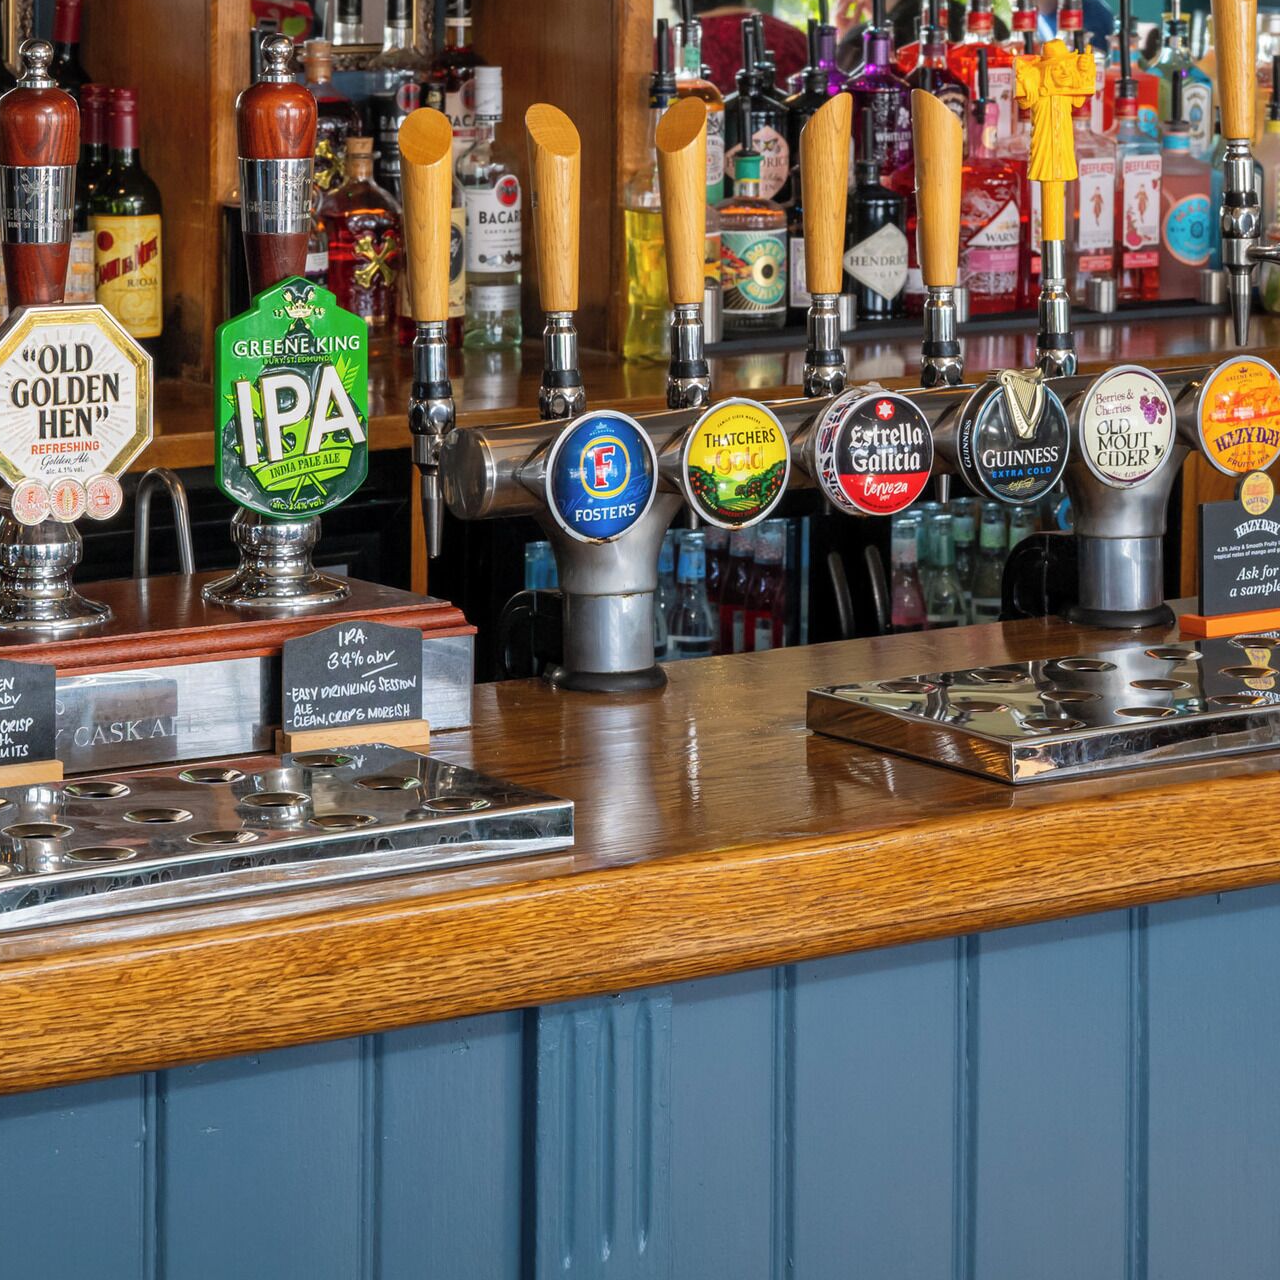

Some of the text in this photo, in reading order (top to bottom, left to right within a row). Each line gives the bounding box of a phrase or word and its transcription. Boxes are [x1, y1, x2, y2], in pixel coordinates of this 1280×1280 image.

[1080, 163, 1115, 175] BEEFEATER
[1124, 159, 1161, 172] BEEFEATER
[478, 209, 521, 226] BACAR
[850, 254, 907, 267] HENDRIC
[233, 335, 361, 357] GREENE KING
[10, 372, 120, 409] GOLDEN
[1095, 389, 1135, 405] Berries &
[234, 364, 367, 467] IPA
[1095, 403, 1131, 416] Cherries
[849, 422, 924, 449] Estrella
[1096, 418, 1131, 436] OLD
[704, 428, 776, 448] THATCHERS
[963, 419, 972, 469] GUINNESS
[1097, 431, 1152, 451] MOUT
[1214, 426, 1256, 453] HAZY
[31, 441, 100, 455] REFRESHING
[982, 445, 1060, 468] GUINNESS
[40, 452, 91, 470] Golden Ale
[270, 452, 341, 479] INDIA PALE ALE
[593, 444, 616, 490] F
[716, 446, 765, 475] Gold
[852, 446, 921, 472] Galicia
[1096, 449, 1150, 467] CIDER
[1227, 457, 1255, 468] FRUITY
[991, 465, 1052, 479] EXTRA COLD
[863, 473, 909, 497] Cerveza
[575, 503, 637, 523] FOSTER'S
[1233, 519, 1261, 539] HAZY
[1245, 542, 1264, 550] Smooth
[1236, 564, 1280, 581] Ask for
[1229, 587, 1238, 598] a
[366, 649, 396, 664] abv
[320, 680, 377, 699] DRINKING
[378, 675, 417, 692] SESSION
[367, 703, 411, 719] MOREISH
[0, 717, 34, 733] CRISP
[74, 719, 144, 747] CASK
